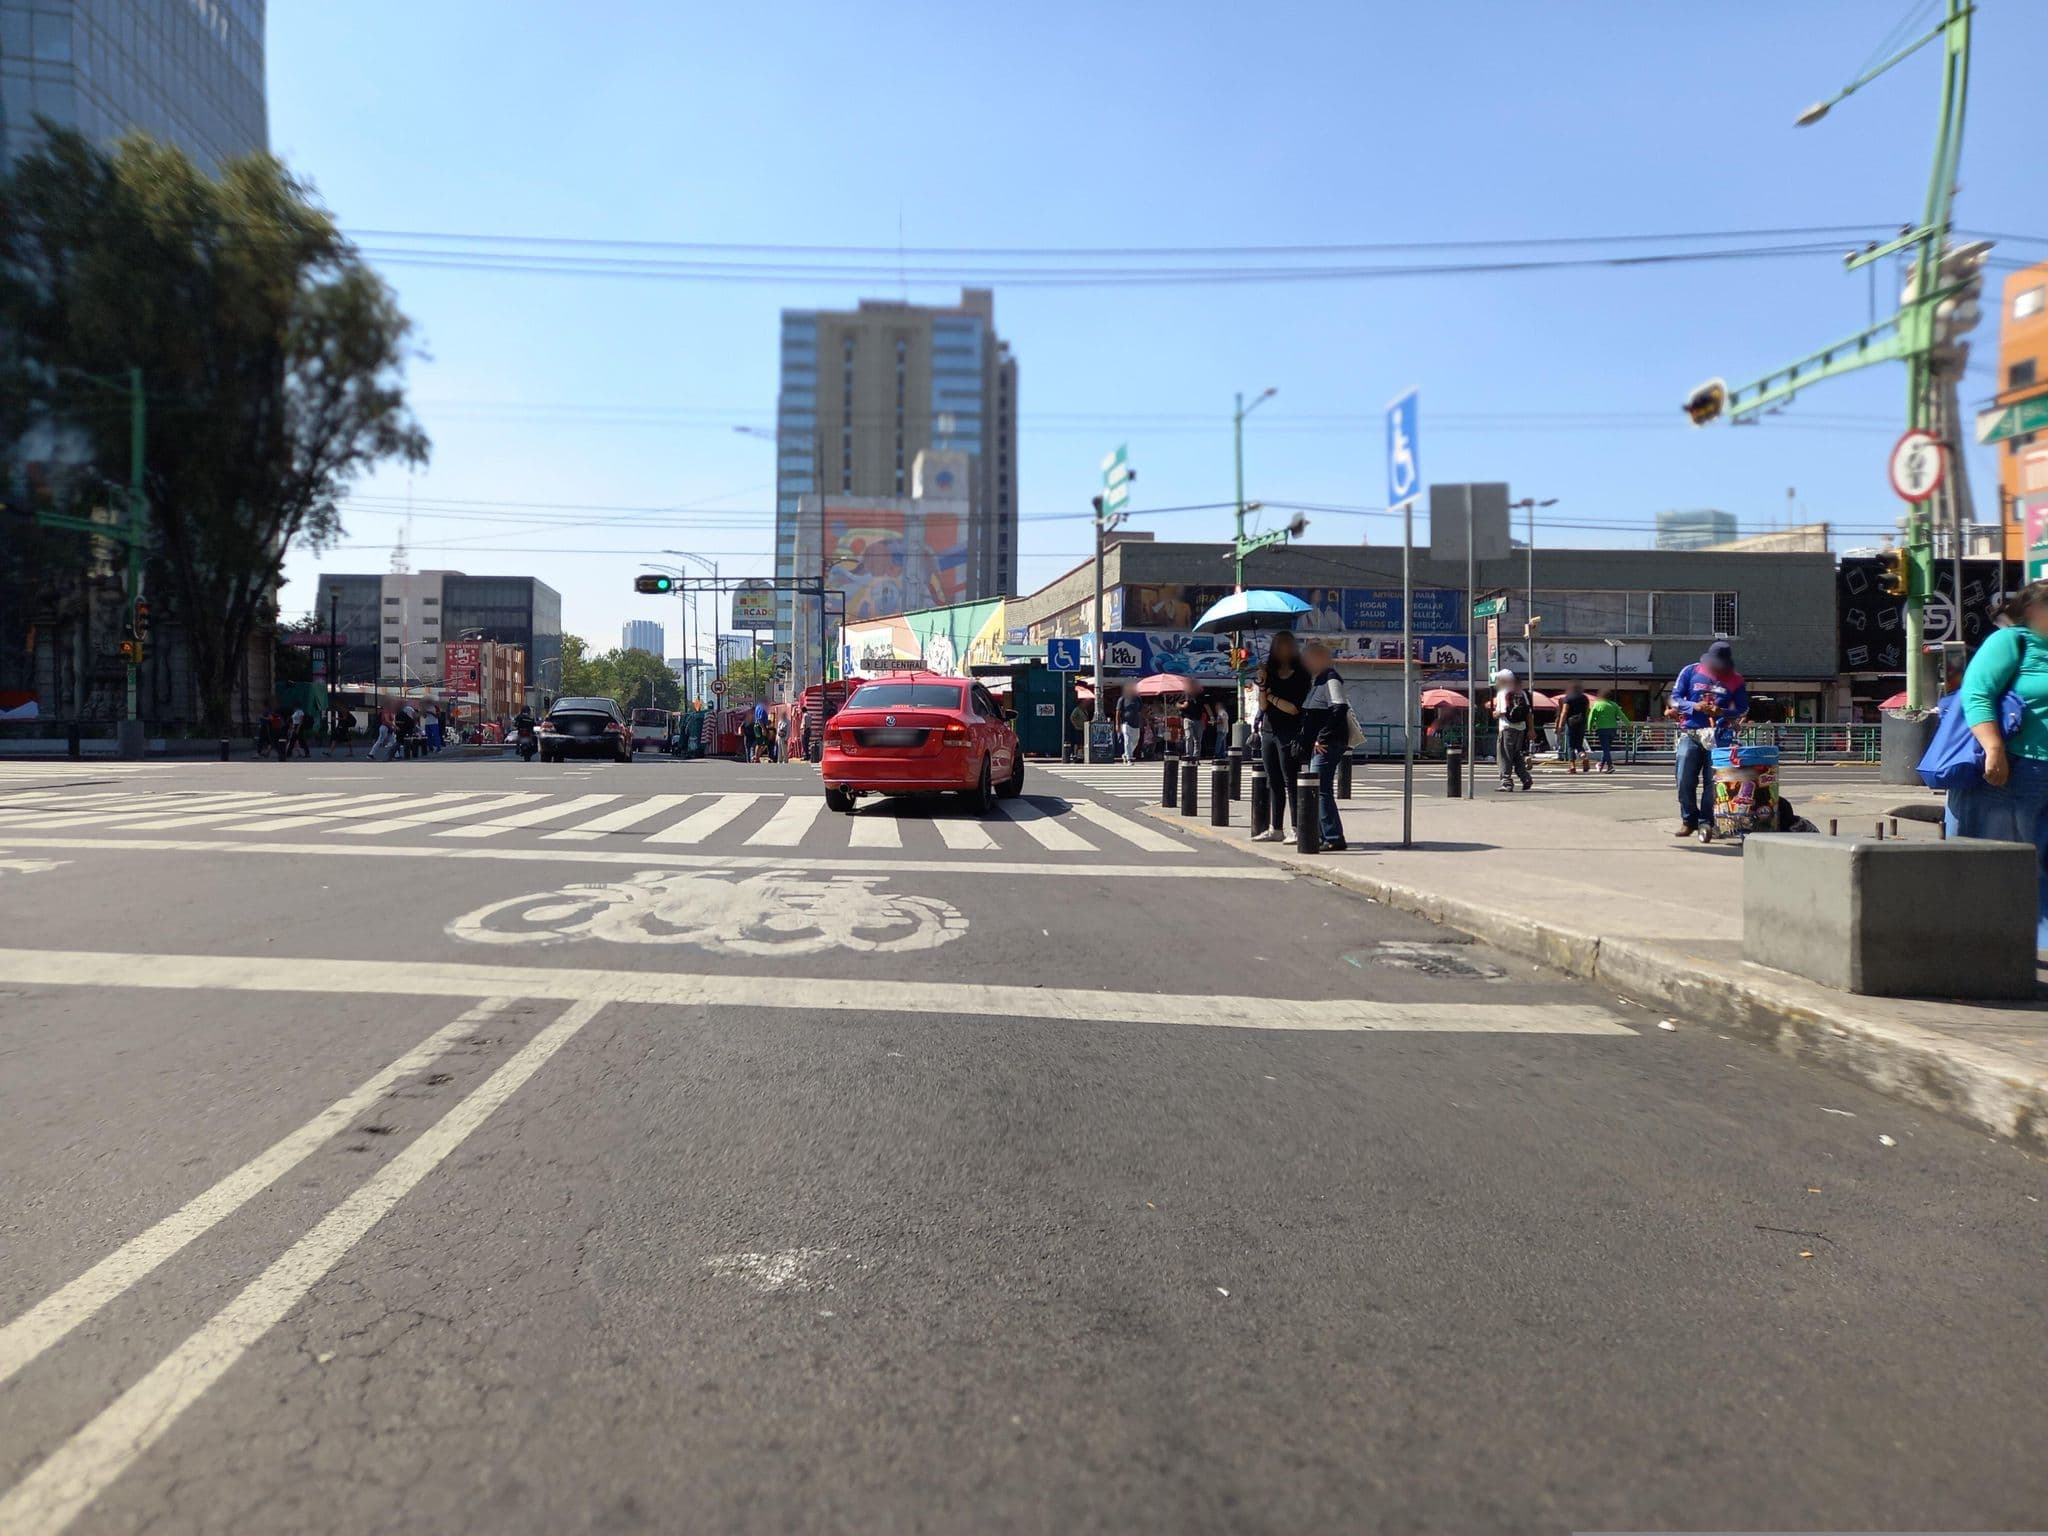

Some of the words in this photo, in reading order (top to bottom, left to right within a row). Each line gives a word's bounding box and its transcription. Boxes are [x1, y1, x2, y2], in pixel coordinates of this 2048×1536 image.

[1360, 601, 1388, 609] HOGAR
[1412, 602, 1444, 610] EGALAR
[1360, 610, 1386, 618] SALUD
[1412, 611, 1442, 619] ELLEZA
[1388, 620, 1401, 630] DE
[1413, 620, 1453, 630] HIBICIÓN
[1112, 648, 1129, 656] MA
[874, 660, 889, 670] EJE
[891, 661, 923, 671] CENTRAL
